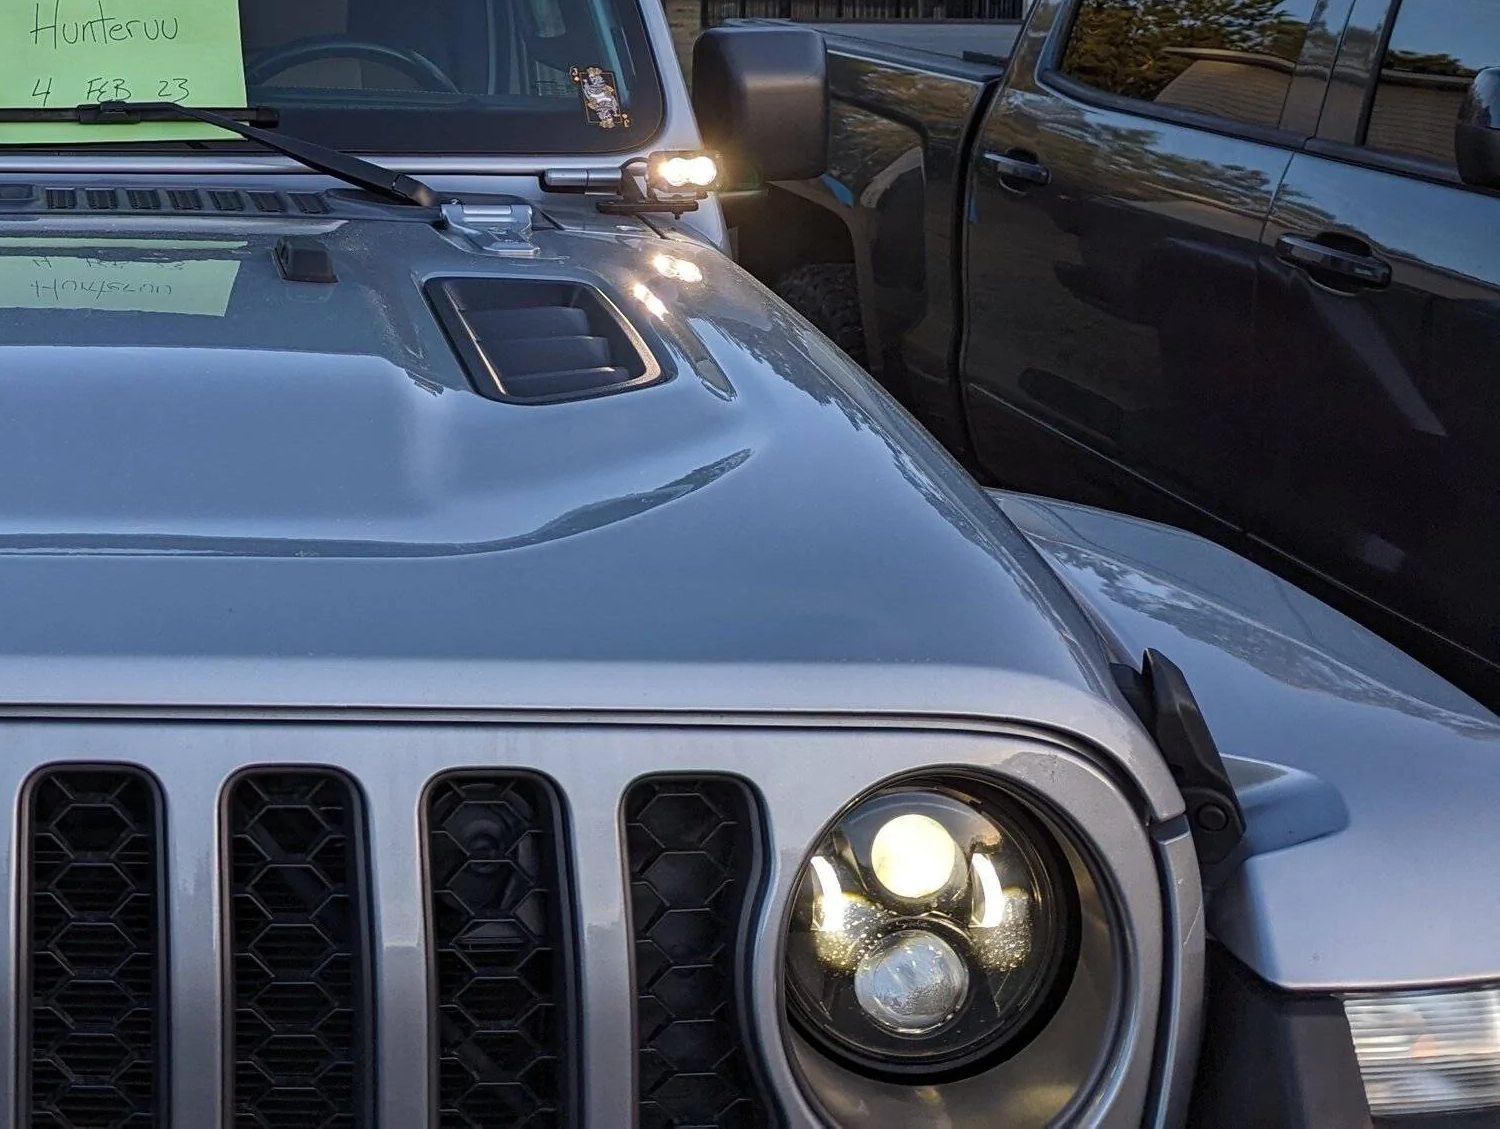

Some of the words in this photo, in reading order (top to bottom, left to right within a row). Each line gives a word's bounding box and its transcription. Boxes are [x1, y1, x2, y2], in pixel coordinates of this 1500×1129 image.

[32, 77, 53, 107] 4
[86, 77, 132, 103] FEB
[157, 78, 190, 103] 23
